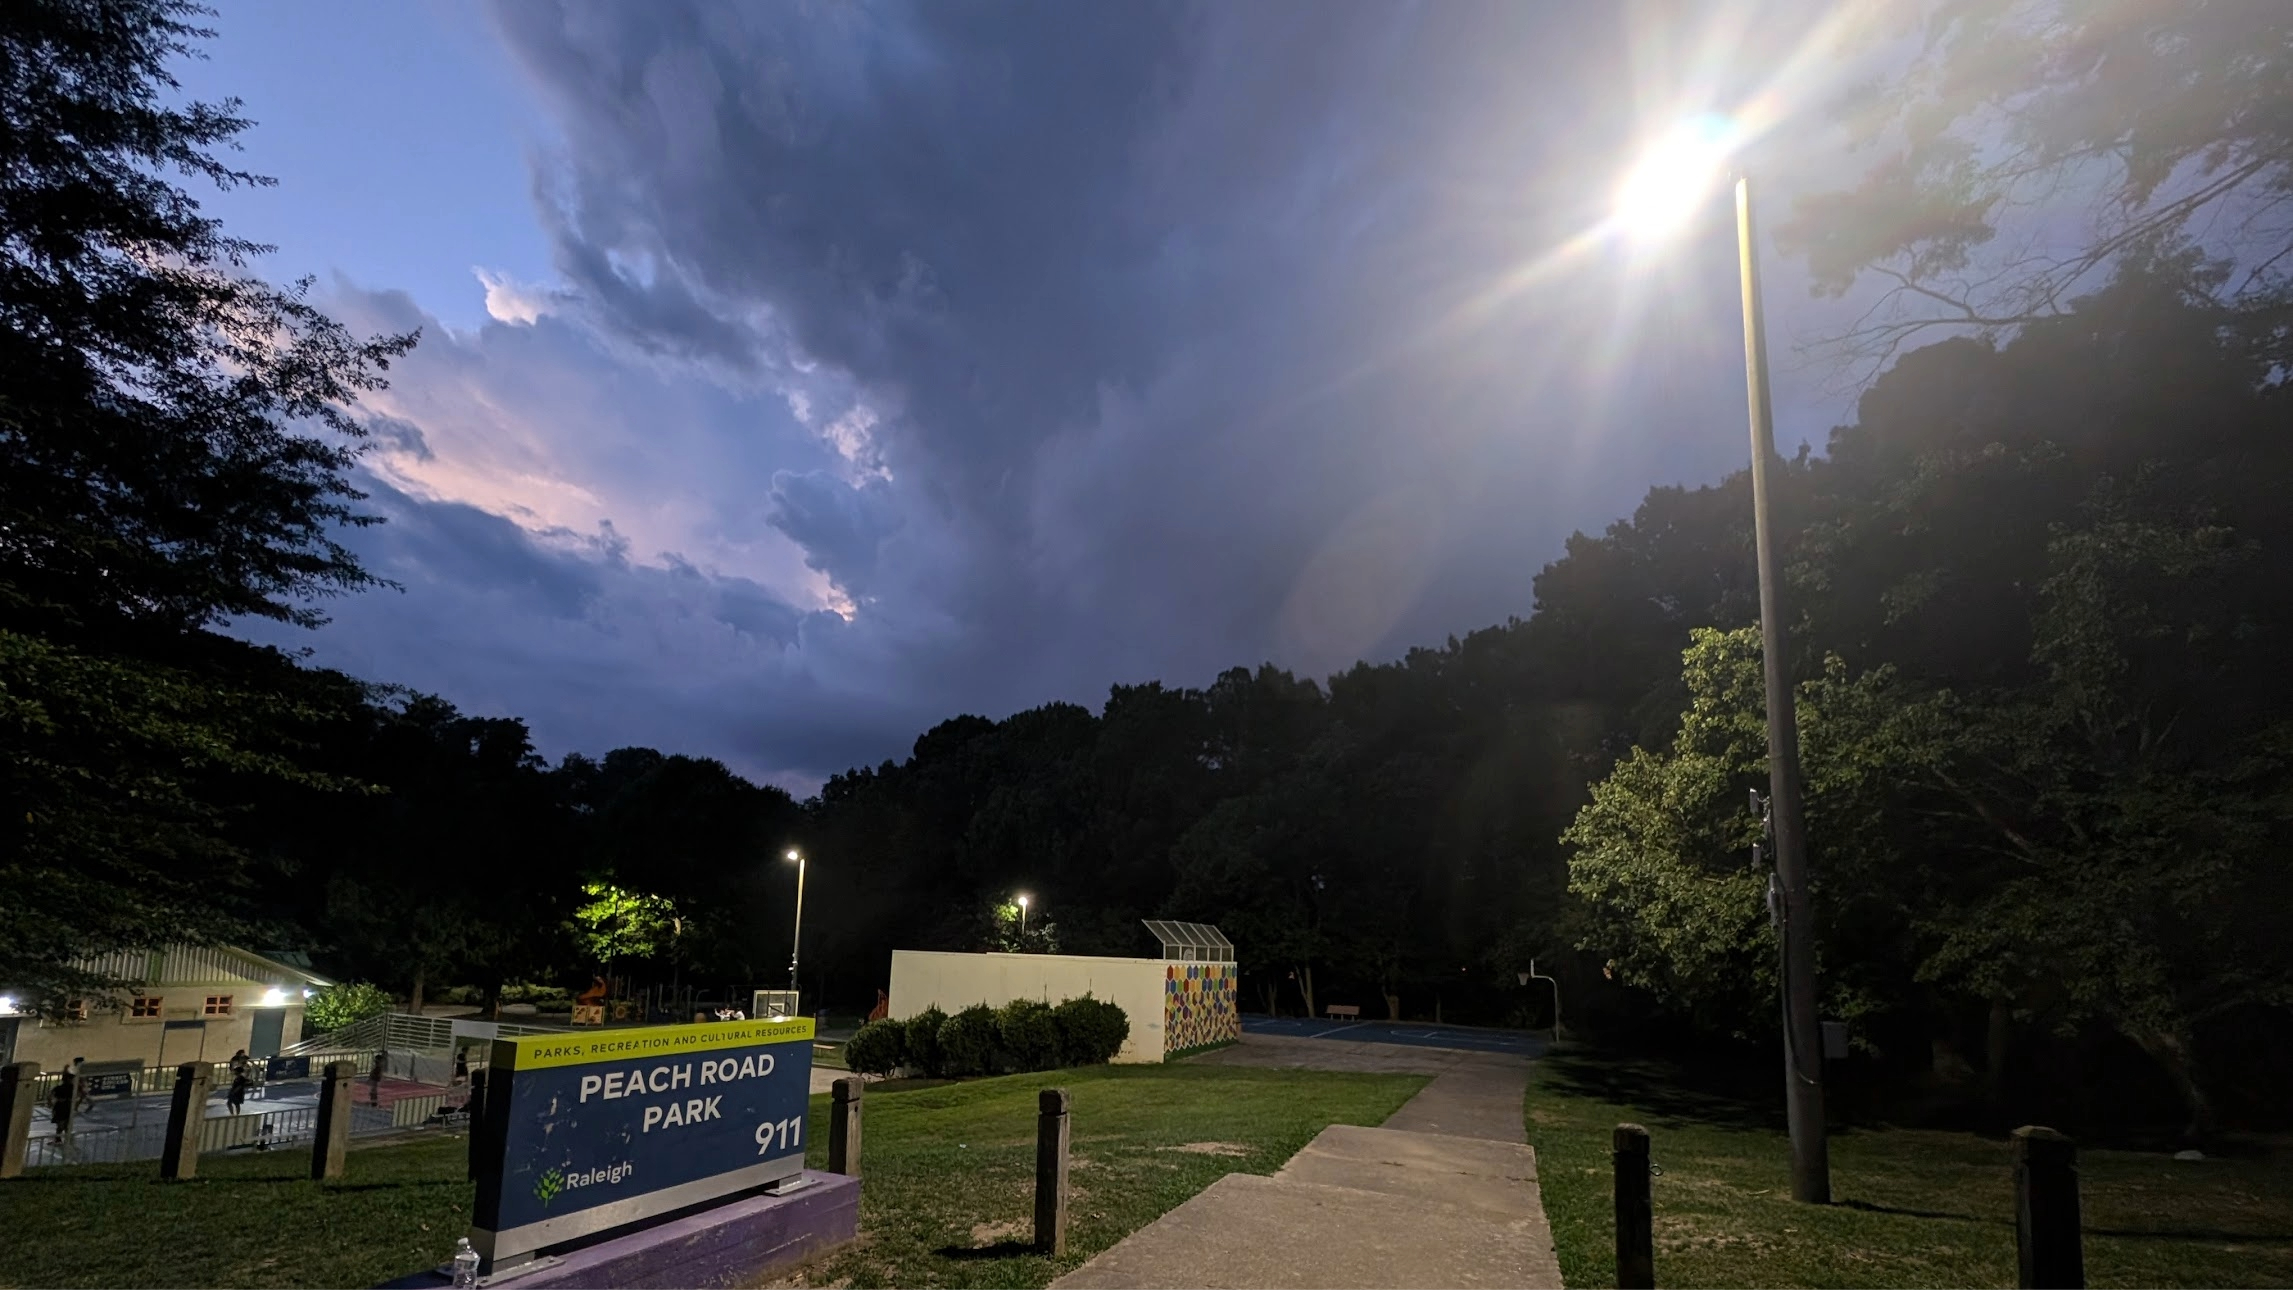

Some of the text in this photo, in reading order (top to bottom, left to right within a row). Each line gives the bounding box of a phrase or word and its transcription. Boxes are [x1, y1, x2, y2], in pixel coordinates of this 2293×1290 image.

[534, 1025, 807, 1059] PARKS, RECREATION AND CULTURAL RESOURCES
[579, 1053, 775, 1103] PEACH ROAD
[642, 1095, 723, 1133] PARK
[755, 1115, 801, 1156] 911
[566, 1161, 632, 1190] Raleigh
